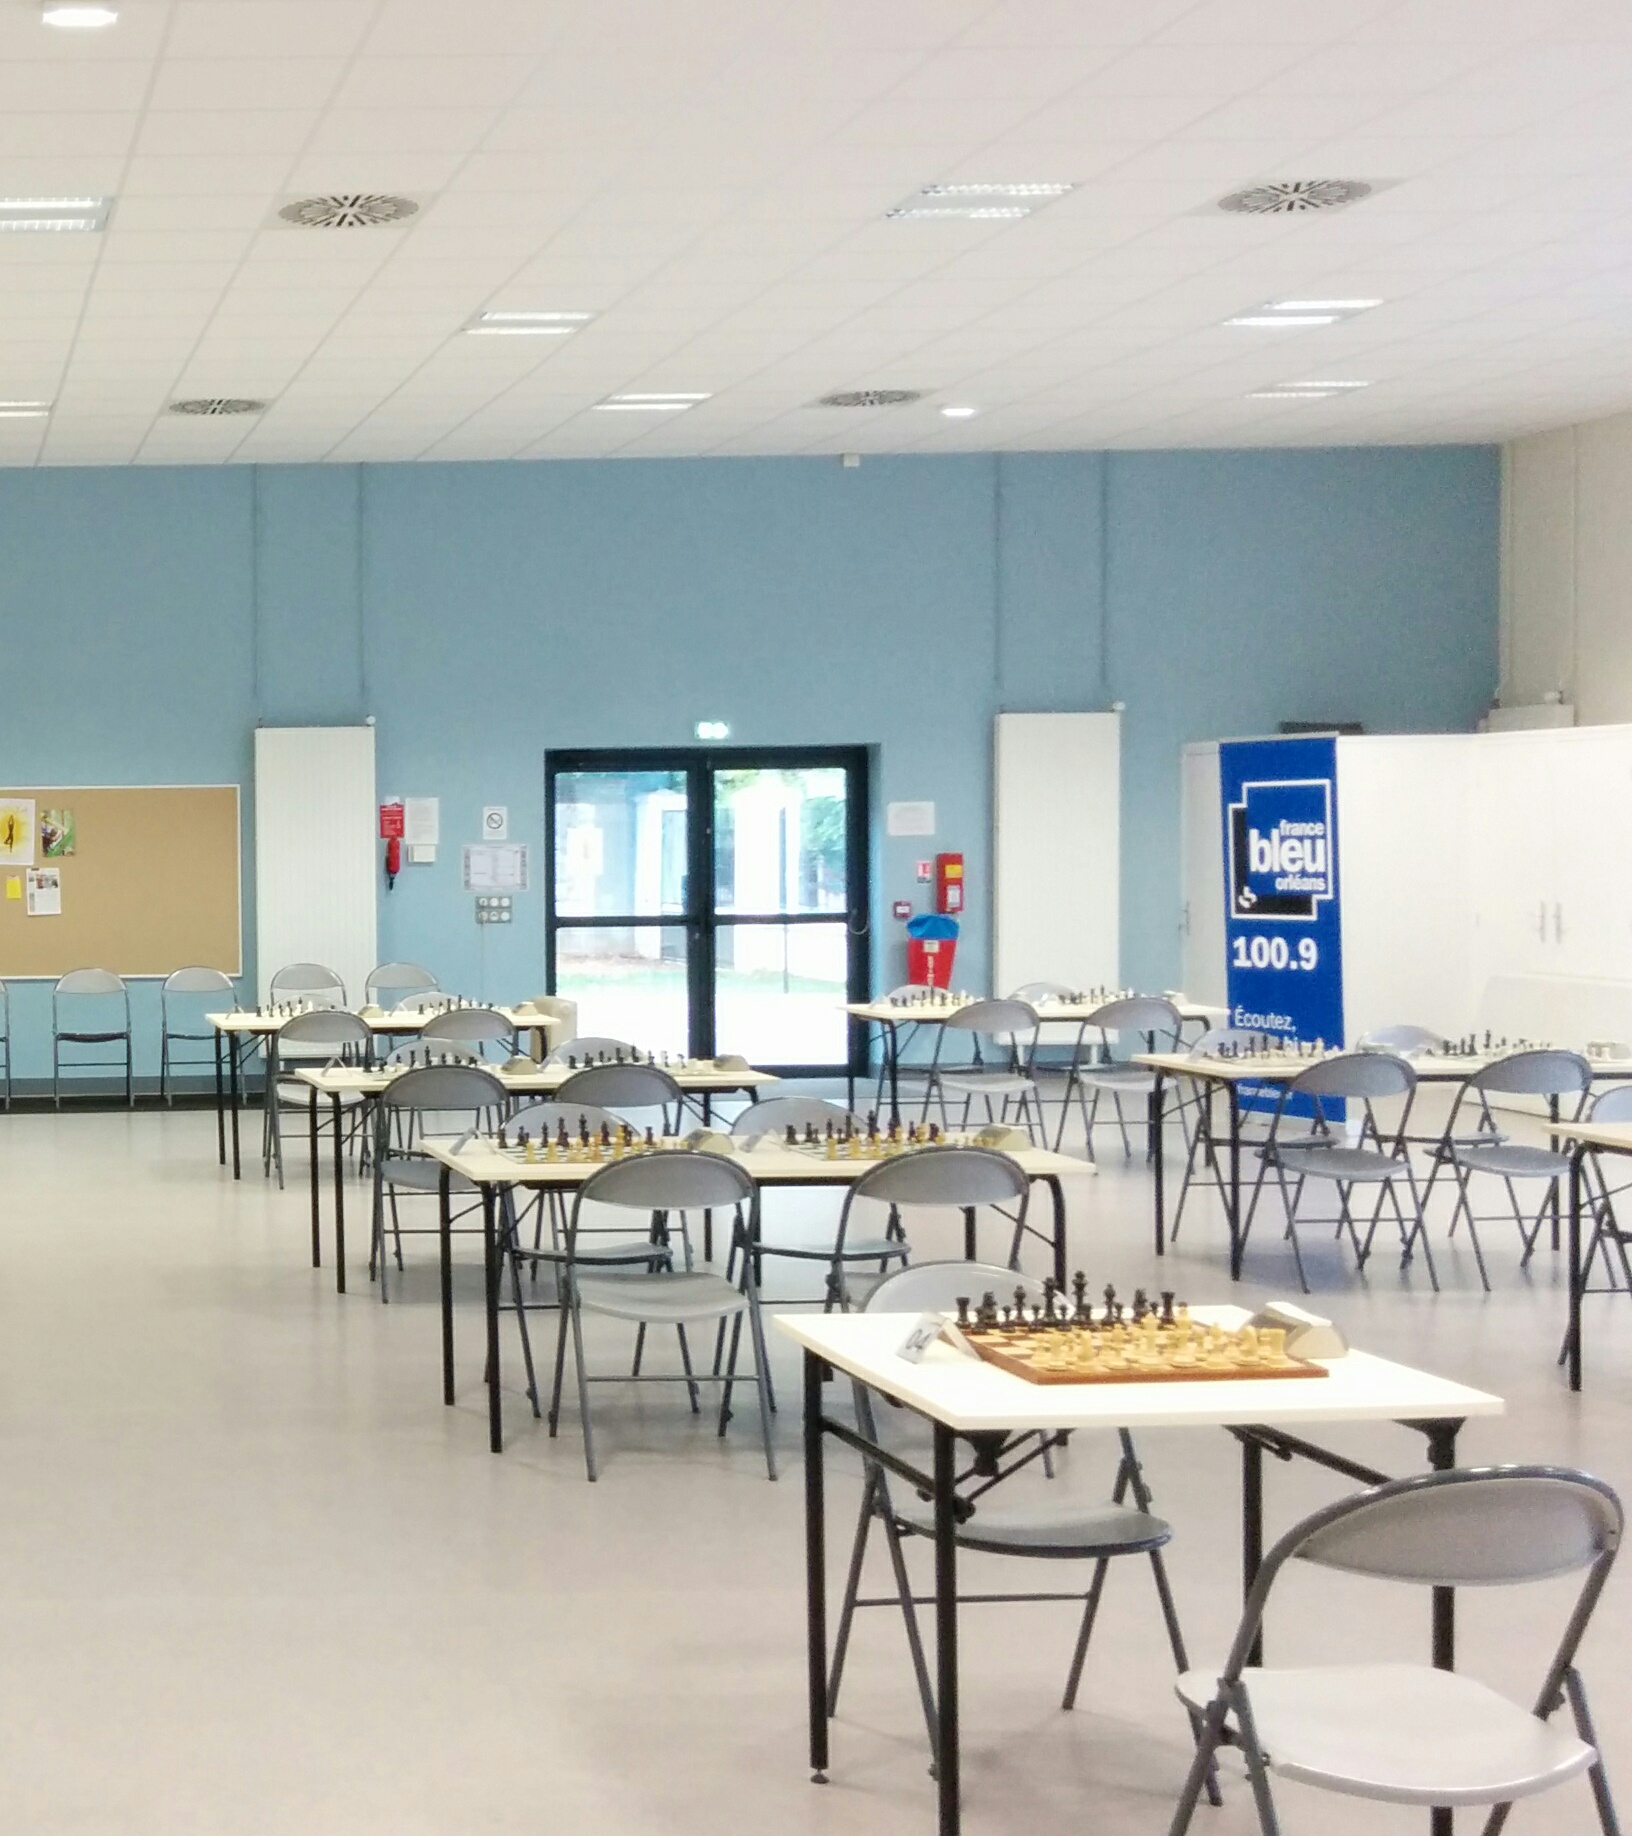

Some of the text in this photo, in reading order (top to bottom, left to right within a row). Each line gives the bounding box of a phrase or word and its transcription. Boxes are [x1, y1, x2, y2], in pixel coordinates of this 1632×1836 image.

[1279, 819, 1325, 837] france
[1248, 828, 1327, 873] bleu
[1275, 873, 1326, 891] orléans
[1232, 935, 1318, 971] 100.9
[1234, 1005, 1297, 1032] Écoutez,
